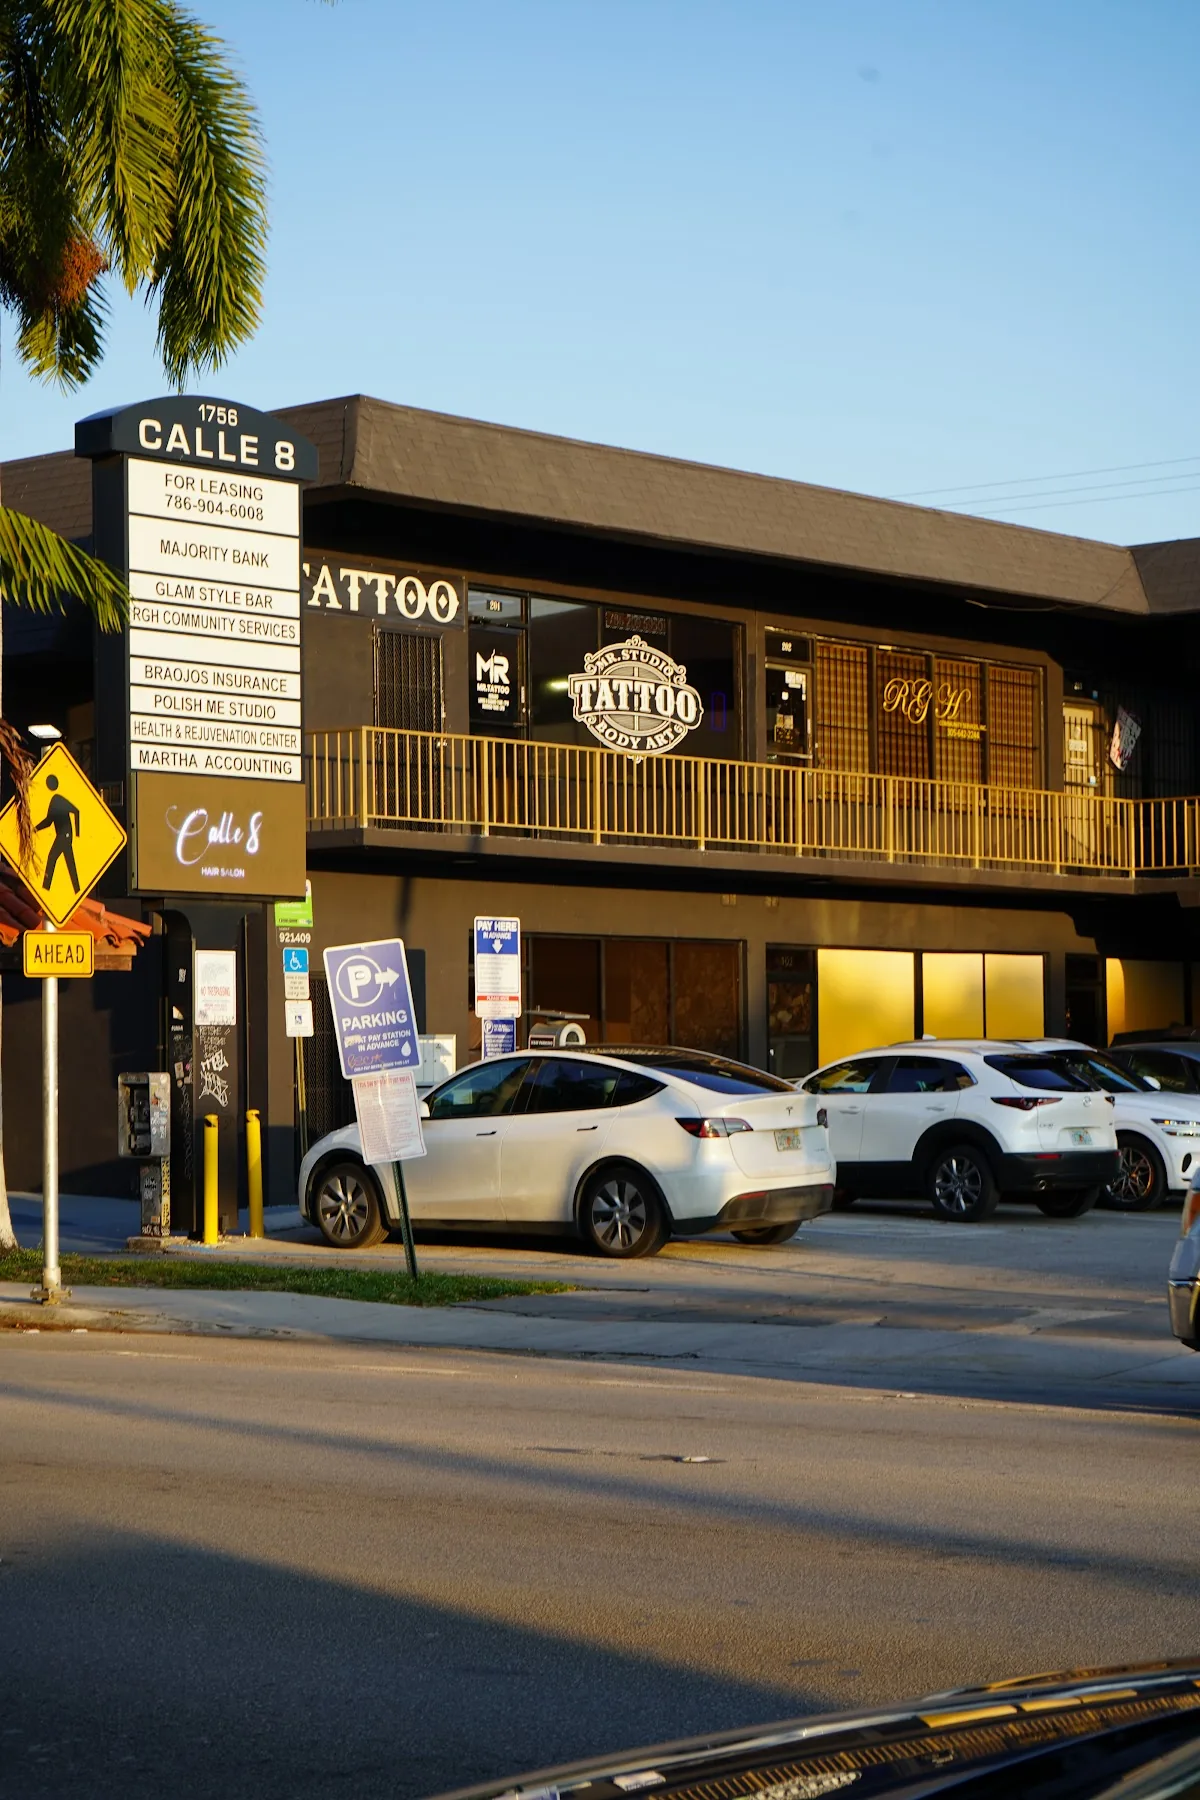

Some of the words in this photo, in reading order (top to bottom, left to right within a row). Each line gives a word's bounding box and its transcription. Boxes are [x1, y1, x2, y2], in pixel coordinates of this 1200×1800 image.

[198, 404, 238, 427] 1756
[138, 418, 259, 466] CALLE
[274, 440, 295, 471] 8
[165, 473, 195, 492] FOR
[200, 478, 264, 501] LEASING
[165, 494, 264, 521] 786-904-6008
[160, 539, 229, 562] MAJORITY
[232, 549, 269, 568] BANK
[155, 581, 195, 599] GLAM
[199, 587, 241, 605] STYLE
[246, 593, 273, 609] BAR
[303, 563, 460, 623] ATTOO
[133, 607, 159, 623] RGH
[163, 610, 235, 632] COMMUNITY
[239, 619, 296, 639] SERVICES
[595, 652, 621, 671] MR.
[621, 649, 674, 677] STUDIO
[145, 665, 209, 684] BRAOJOS
[213, 672, 287, 693] INSURANCE
[154, 694, 202, 712] POLISH
[206, 700, 225, 715] ME
[229, 702, 276, 719] STUDIO
[574, 679, 698, 723] TATTOO
[134, 721, 172, 739] HEALTH
[175, 724, 181, 739] &
[184, 725, 257, 745] REJUVENATION
[259, 731, 297, 748] CENTER
[596, 720, 642, 749] BODY
[646, 728, 676, 750] ART
[139, 750, 198, 768] MARTHA
[204, 755, 292, 775] ACCOUNTING
[166, 805, 244, 866] Calle
[201, 866, 219, 876] HAIR
[220, 867, 245, 878] SALON
[279, 932, 311, 943] 921409
[477, 920, 493, 931] PAY
[494, 921, 517, 933] HERE
[489, 932, 512, 940] ADVANCE
[34, 945, 85, 964] AHEAD
[342, 1009, 408, 1032] PARKING
[357, 1045, 365, 1053] IN
[367, 1039, 400, 1051] ADVANCE
[368, 1033, 382, 1043] PAY
[382, 1029, 411, 1041] STATION
